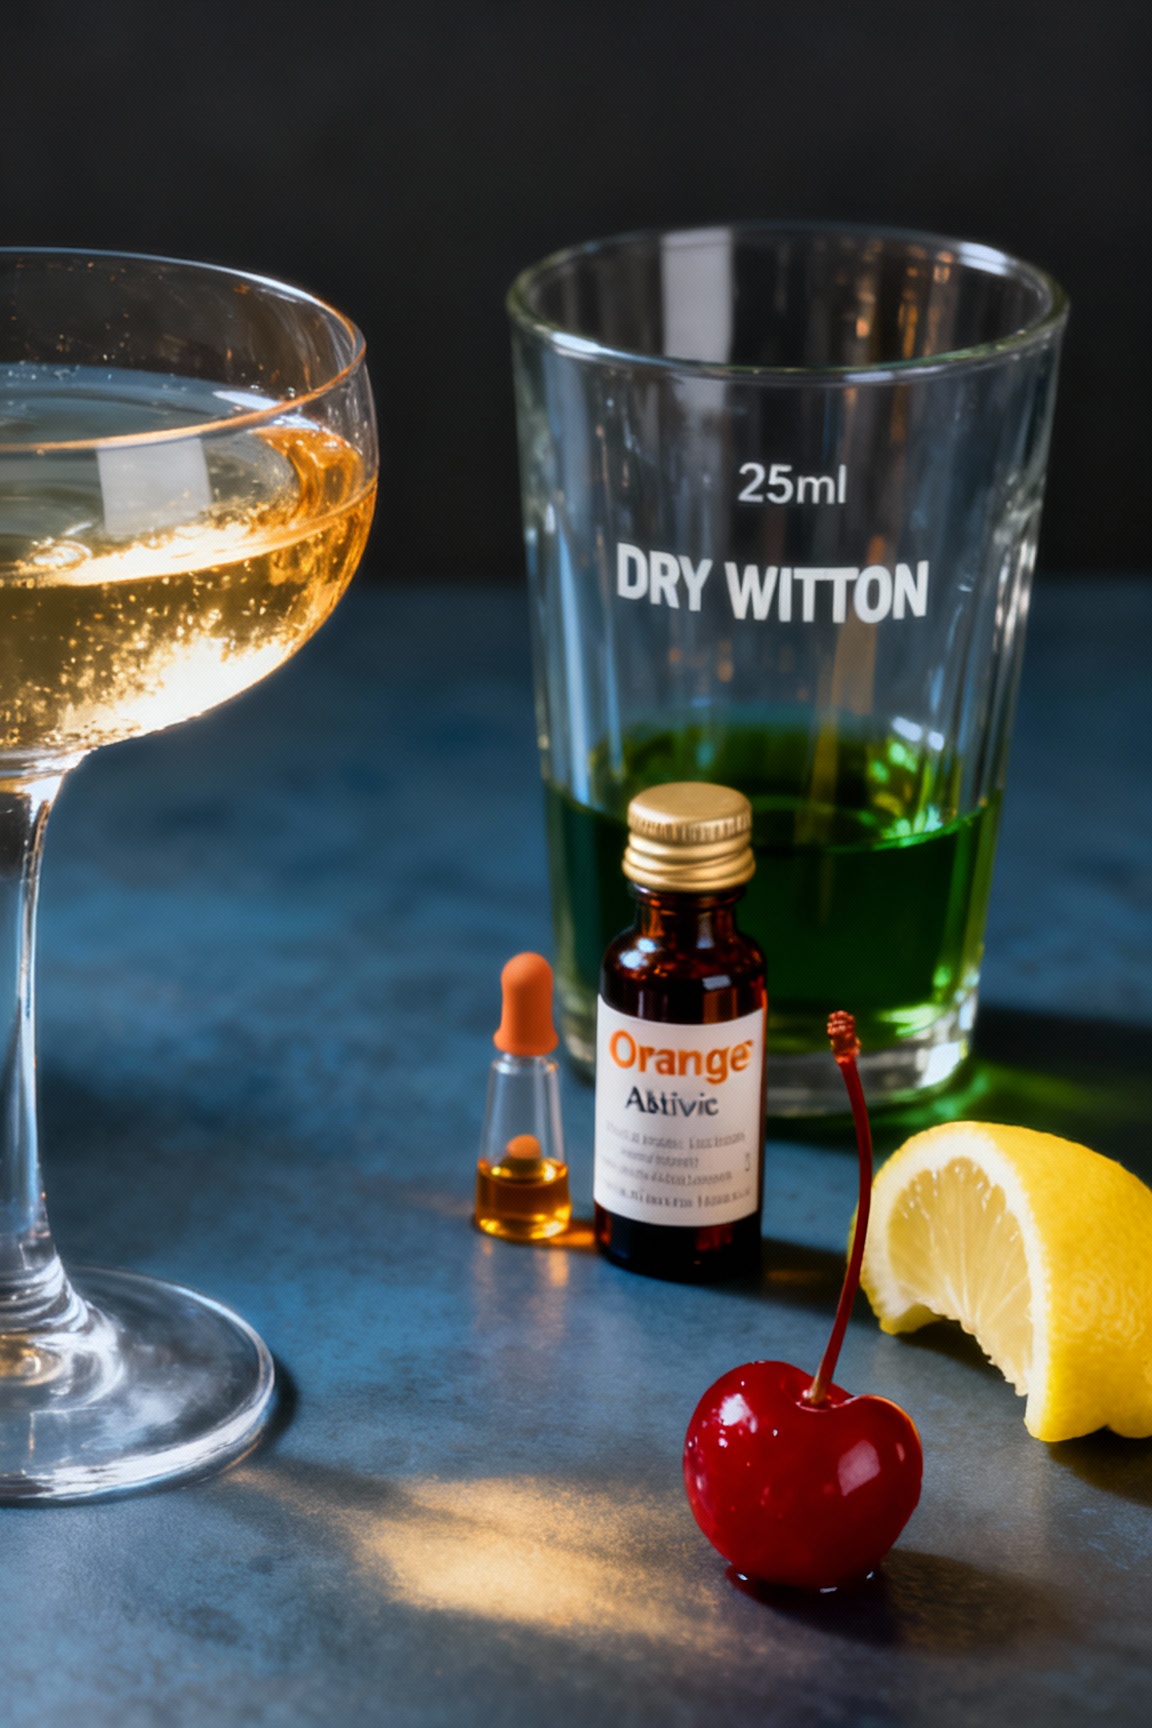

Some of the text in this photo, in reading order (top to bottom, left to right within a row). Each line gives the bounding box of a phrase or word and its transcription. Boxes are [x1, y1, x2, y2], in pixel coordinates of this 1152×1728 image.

[738, 462, 846, 504] 25ml
[617, 542, 929, 624] DRY WITTON
[609, 1029, 753, 1085] Orange
